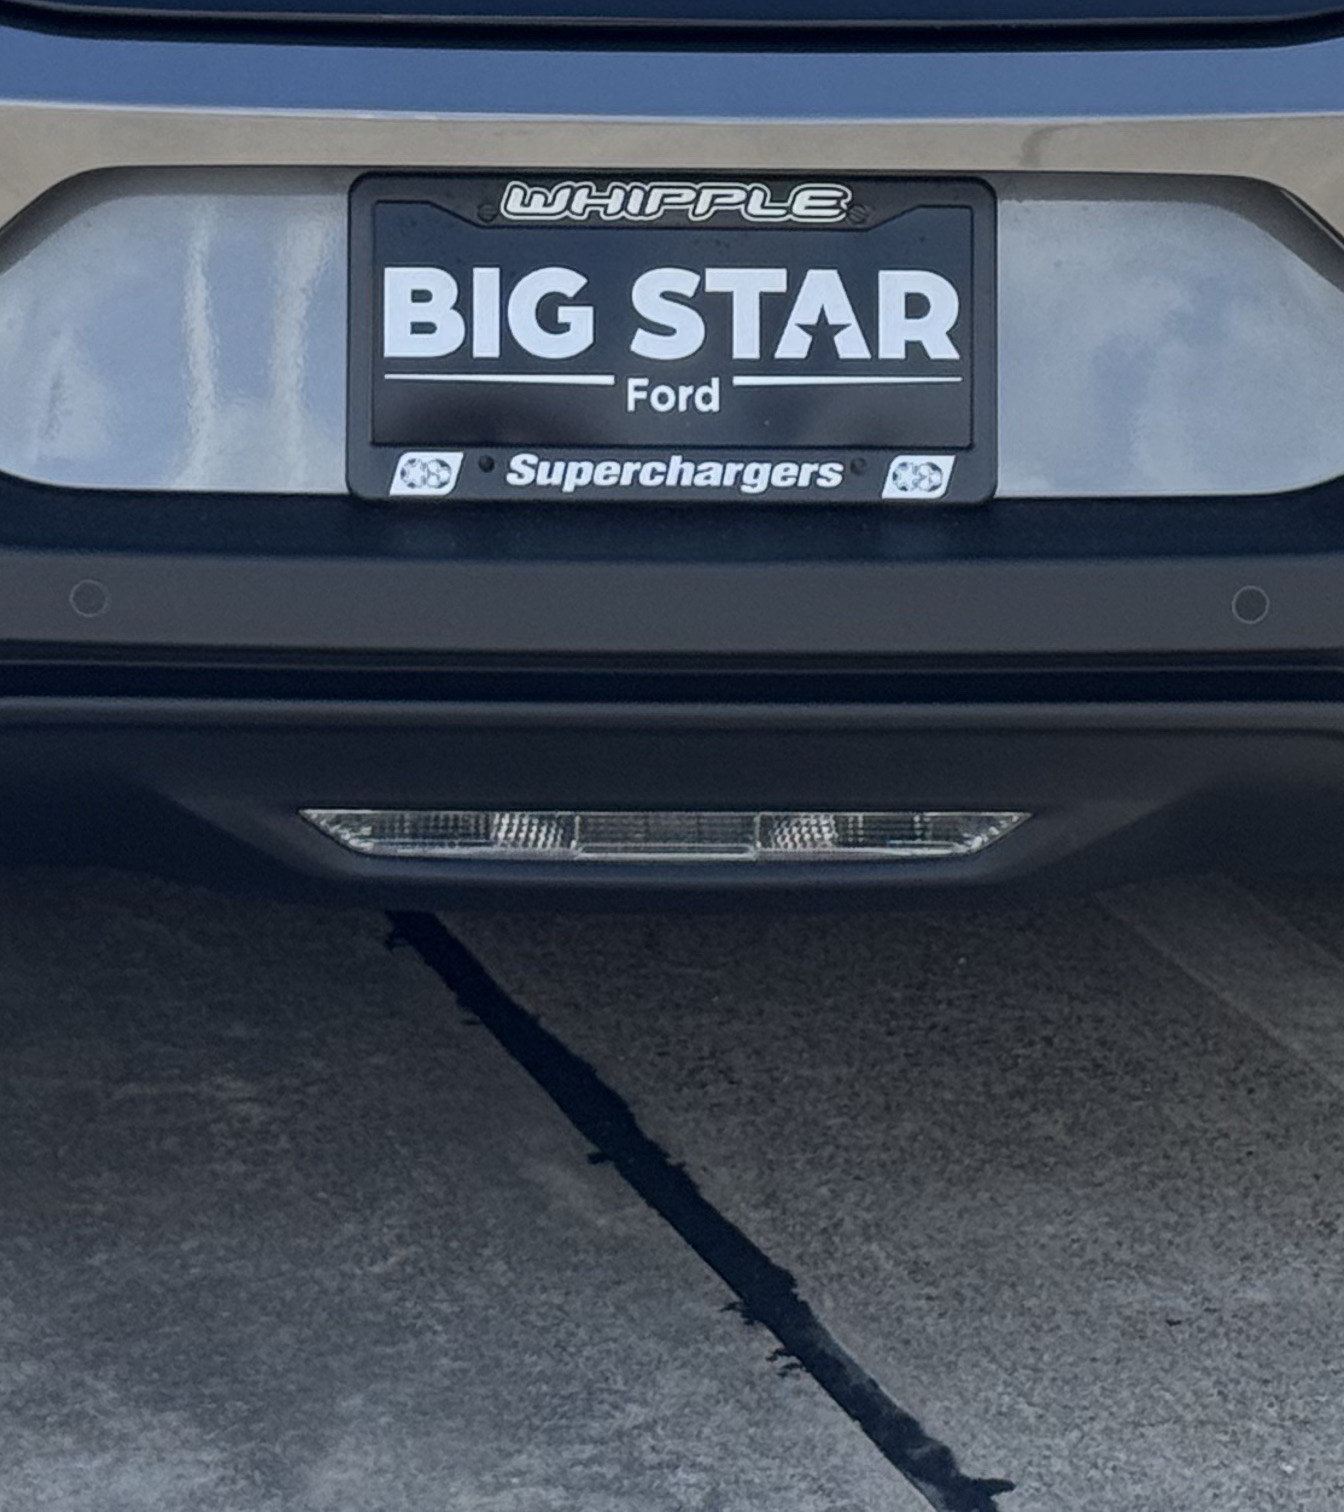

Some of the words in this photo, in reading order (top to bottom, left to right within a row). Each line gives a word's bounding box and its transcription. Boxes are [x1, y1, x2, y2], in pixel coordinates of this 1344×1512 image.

[500, 181, 853, 222] WHIPPLE
[383, 266, 595, 360] BIG
[630, 266, 961, 361] STAR
[626, 377, 721, 413] Ford
[506, 454, 844, 492] Superchargers
